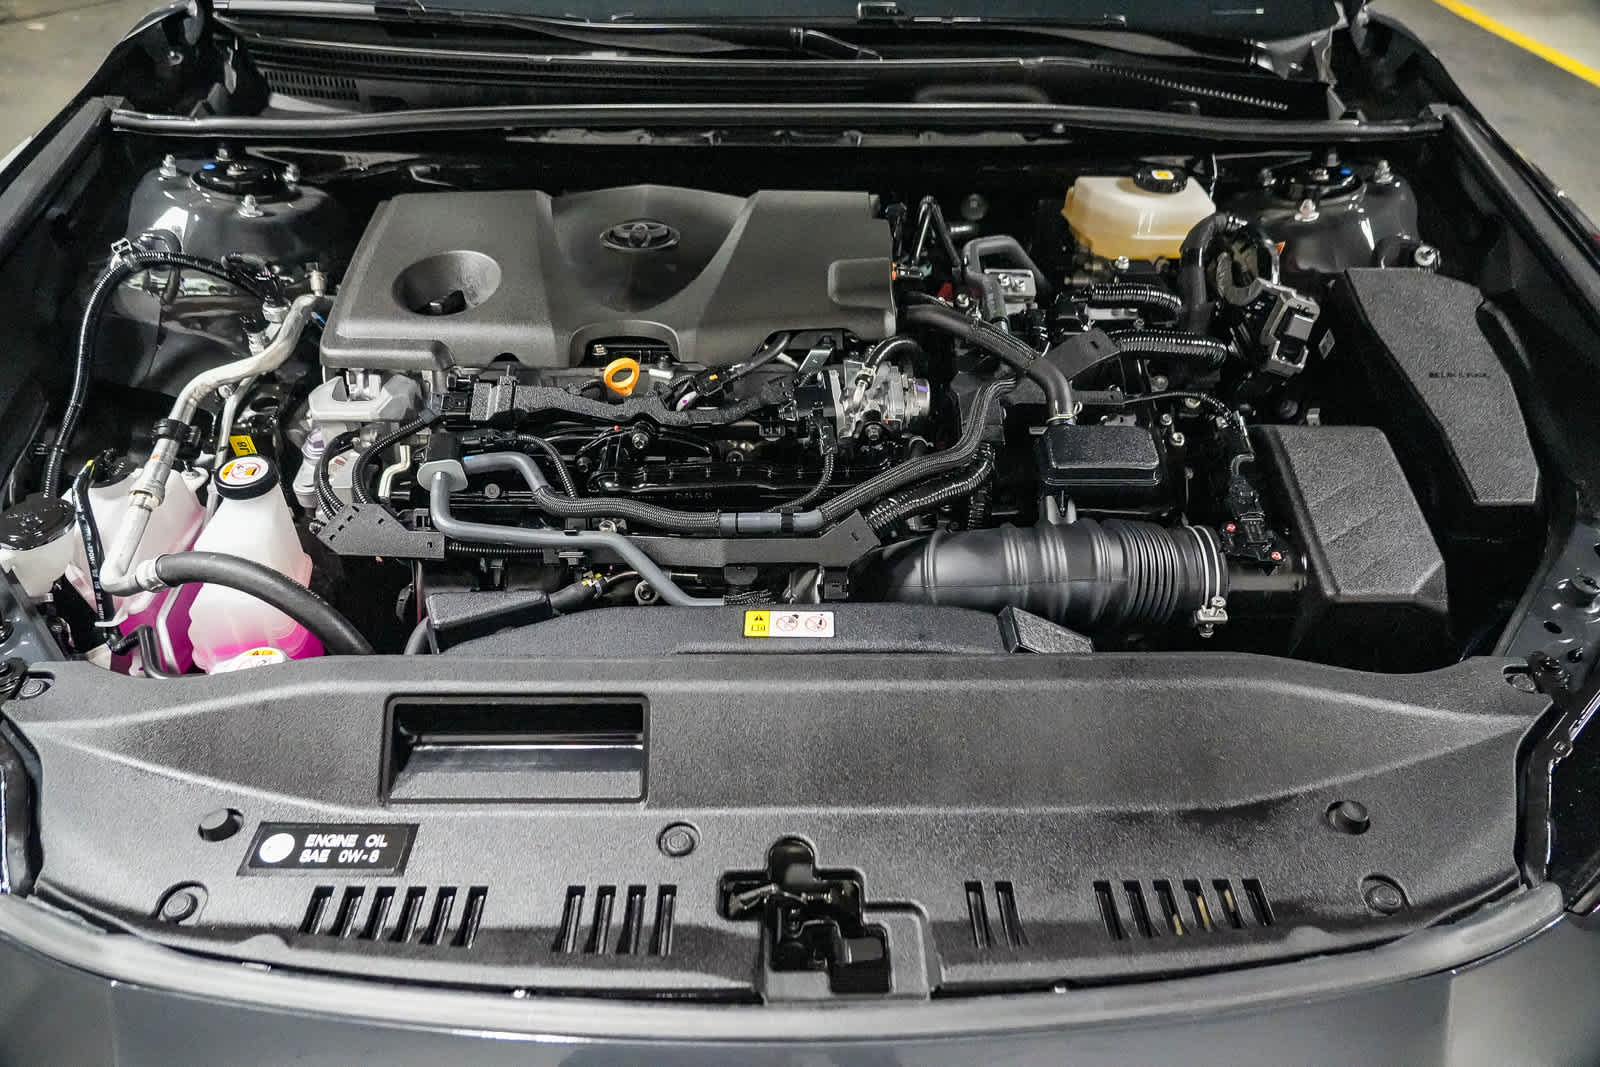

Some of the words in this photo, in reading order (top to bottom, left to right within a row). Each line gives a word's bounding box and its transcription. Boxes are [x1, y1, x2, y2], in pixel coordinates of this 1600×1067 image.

[304, 834, 359, 848] ENGINE
[365, 834, 388, 848] OIL
[299, 849, 331, 863] SAE
